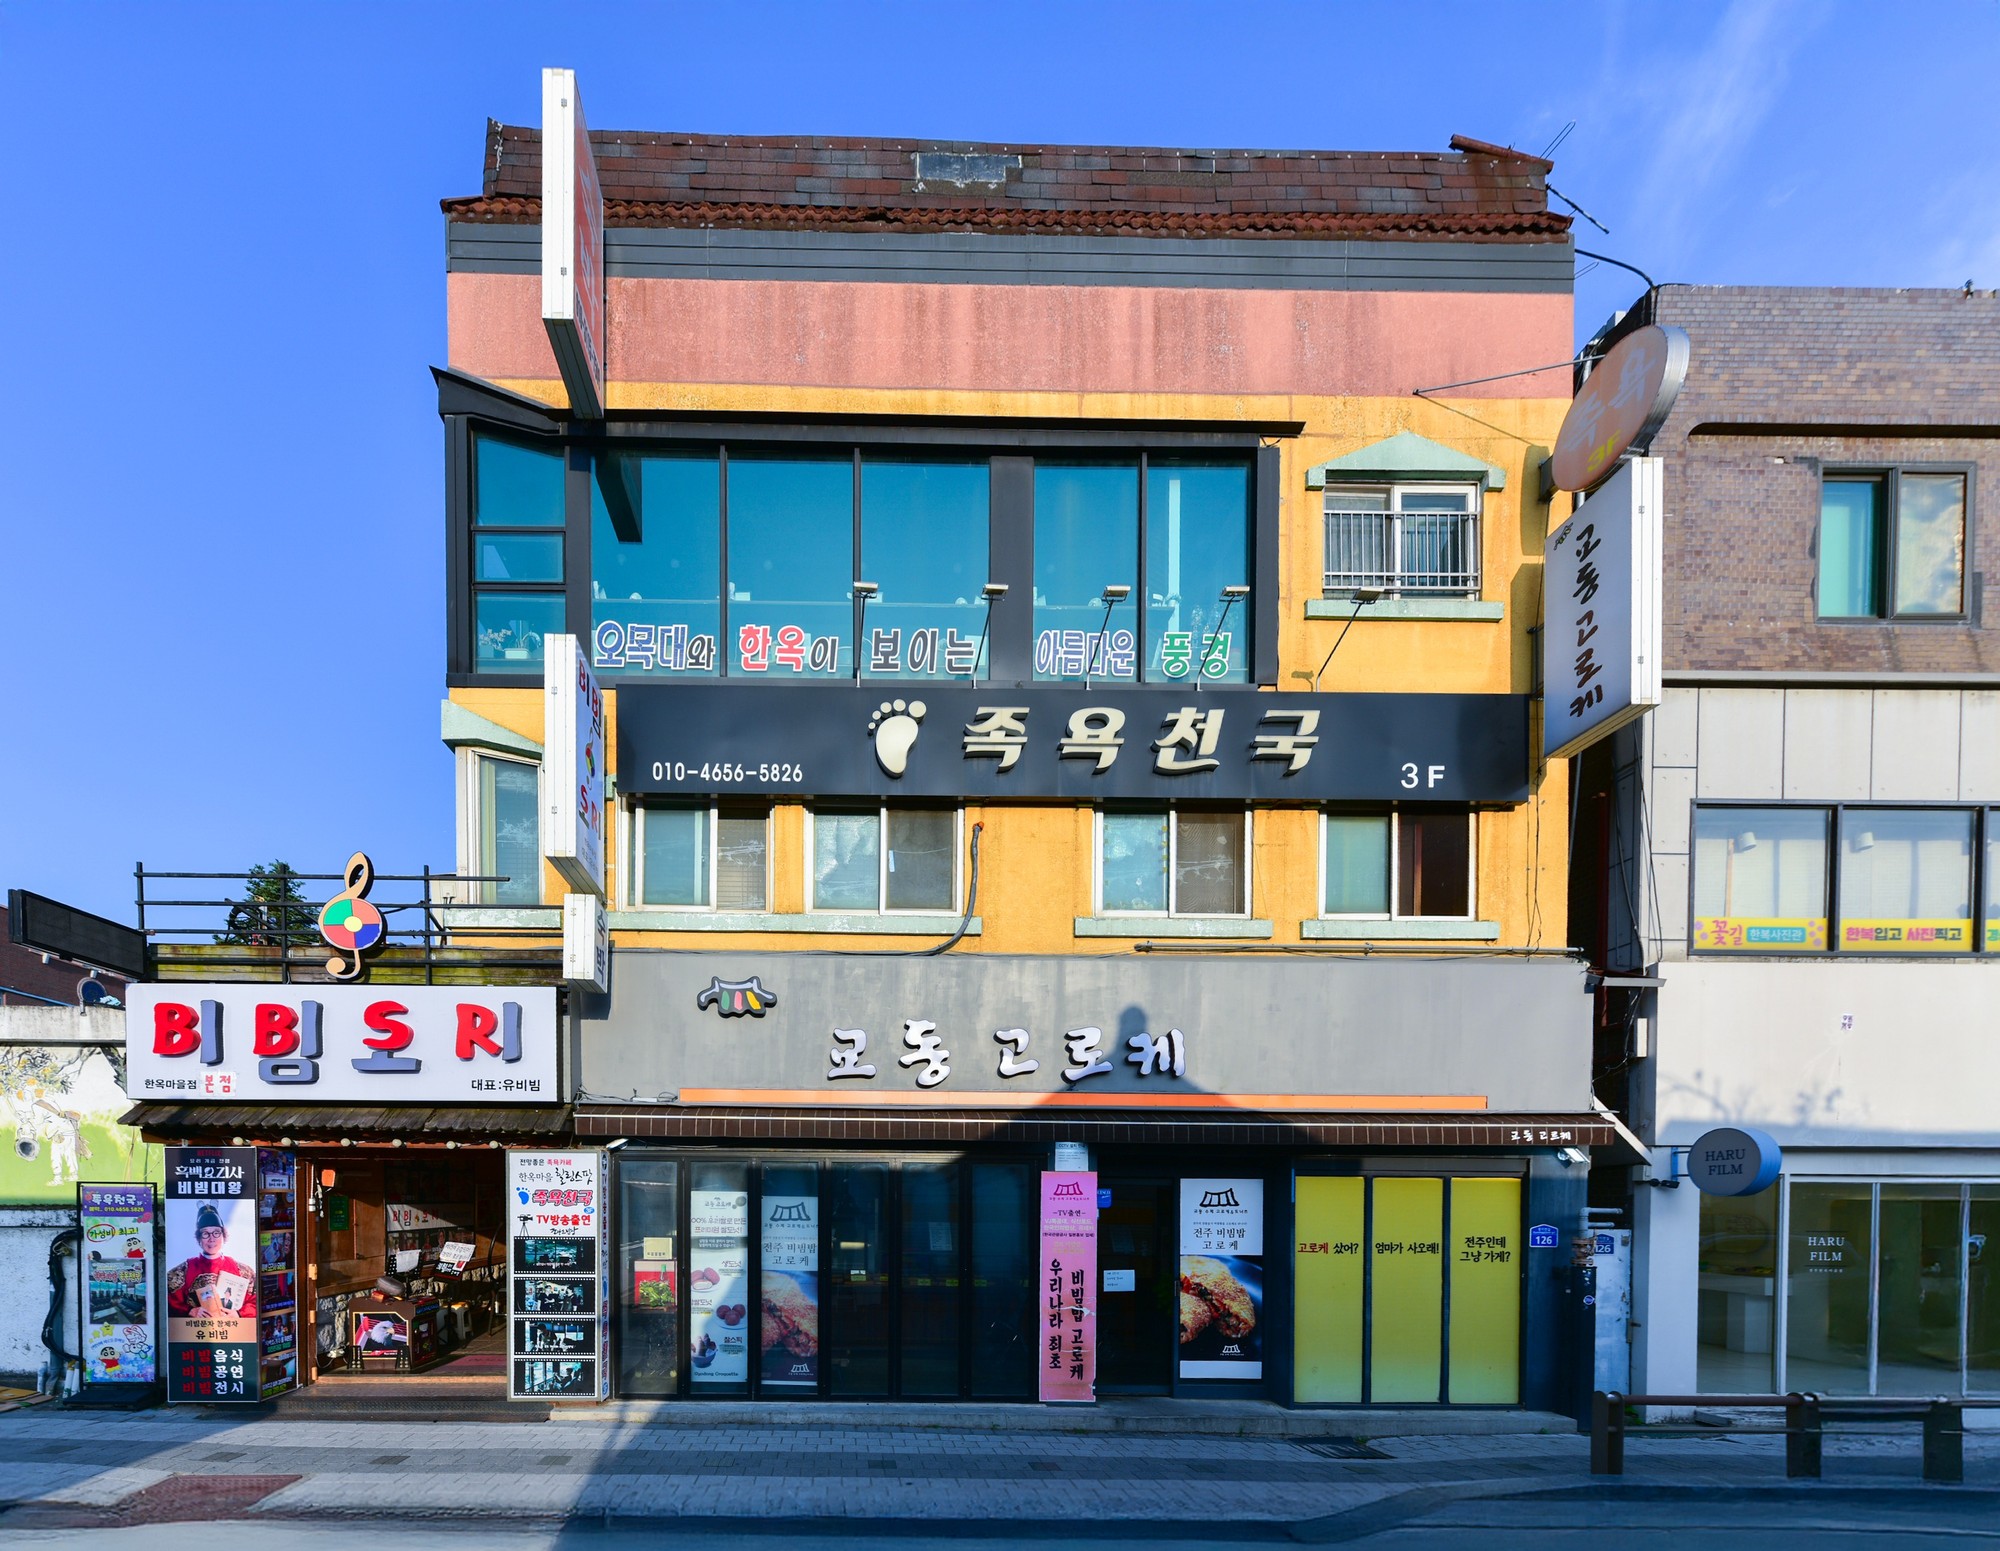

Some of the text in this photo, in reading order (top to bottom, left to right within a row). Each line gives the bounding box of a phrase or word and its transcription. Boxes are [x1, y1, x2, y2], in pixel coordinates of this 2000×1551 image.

[1587, 430, 1621, 473] 3F
[594, 620, 1234, 679] 오목대와 한옥이 보이는 아름다운 풍경
[1569, 609, 1604, 718] 고로케
[962, 704, 1322, 777] 족욕천국
[651, 761, 805, 784] 010-4656-5826
[1711, 919, 1743, 946] 꽃길
[1750, 929, 1802, 941] 한복사진관
[1846, 927, 1962, 941] 한복입고 사진찍고
[826, 1018, 1188, 1088] 교동 고로케
[144, 1074, 232, 1093] 한옥마을점 본점
[1705, 1148, 1746, 1162] HARU
[1708, 1164, 1743, 1176] FILM
[519, 1172, 553, 1183] 한옥마을
[178, 1181, 241, 1195] 비빔대왕
[532, 1189, 594, 1207] 족욕천국
[536, 1214, 591, 1226] TV방송출연
[89, 1227, 139, 1239] 가성비 최고!
[1193, 1228, 1246, 1238] 전주 비빔밥
[1202, 1241, 1238, 1250] 고로케
[1464, 1236, 1506, 1248] 전주인데
[1535, 1236, 1553, 1245] 126
[1808, 1236, 1845, 1246] HARU
[763, 1242, 817, 1253] 전주 비빔밥
[1298, 1243, 1359, 1254] 고로케 샀어?
[1375, 1243, 1440, 1254] 엄마가 사오래!
[772, 1256, 808, 1266] 고로케
[1459, 1251, 1511, 1262] 그냥 가게?
[1810, 1251, 1842, 1261] FILM
[1049, 1259, 1063, 1369] 우리나라 최초
[1070, 1269, 1084, 1380] 비빔밥 고로케
[196, 1330, 228, 1340] 유 비빔
